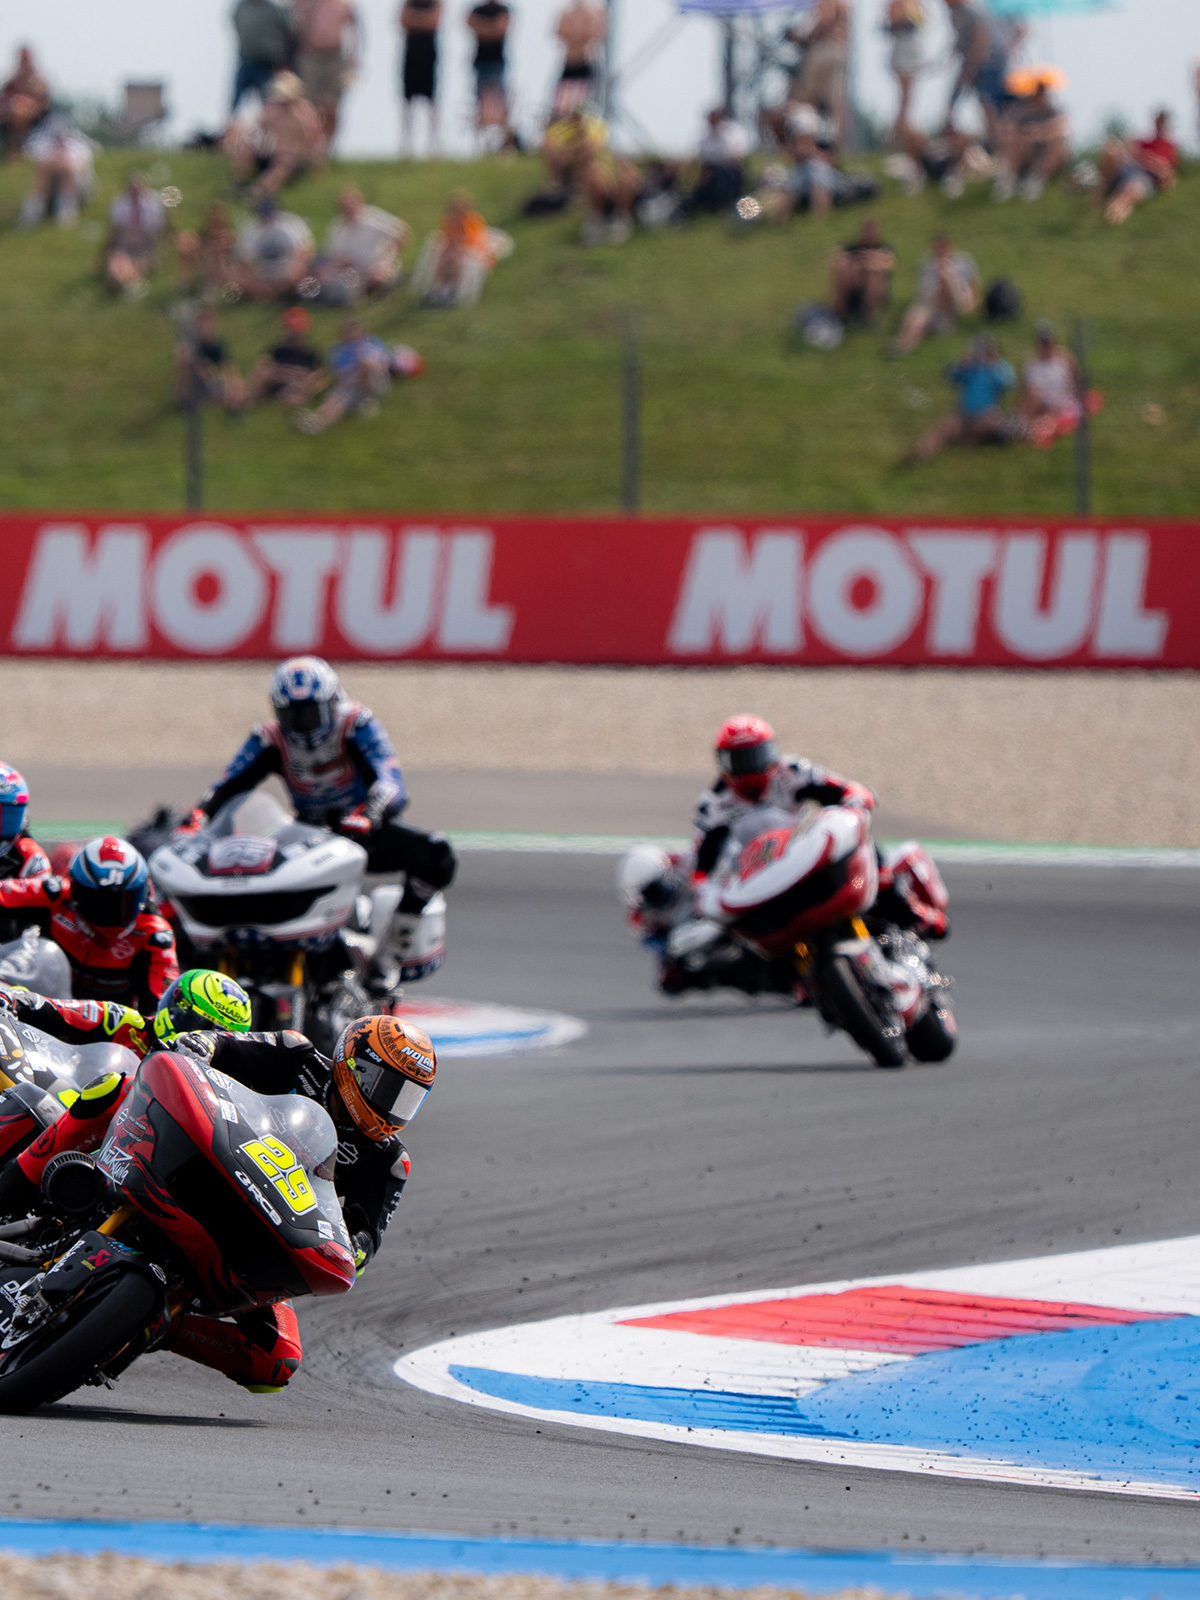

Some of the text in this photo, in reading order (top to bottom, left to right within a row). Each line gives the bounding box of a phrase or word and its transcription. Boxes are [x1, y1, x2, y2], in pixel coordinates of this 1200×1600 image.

[13, 521, 516, 656] MOTUL
[667, 524, 1170, 660] MOTUL
[214, 1001, 246, 1022] SHARK
[239, 1133, 319, 1216] 29
